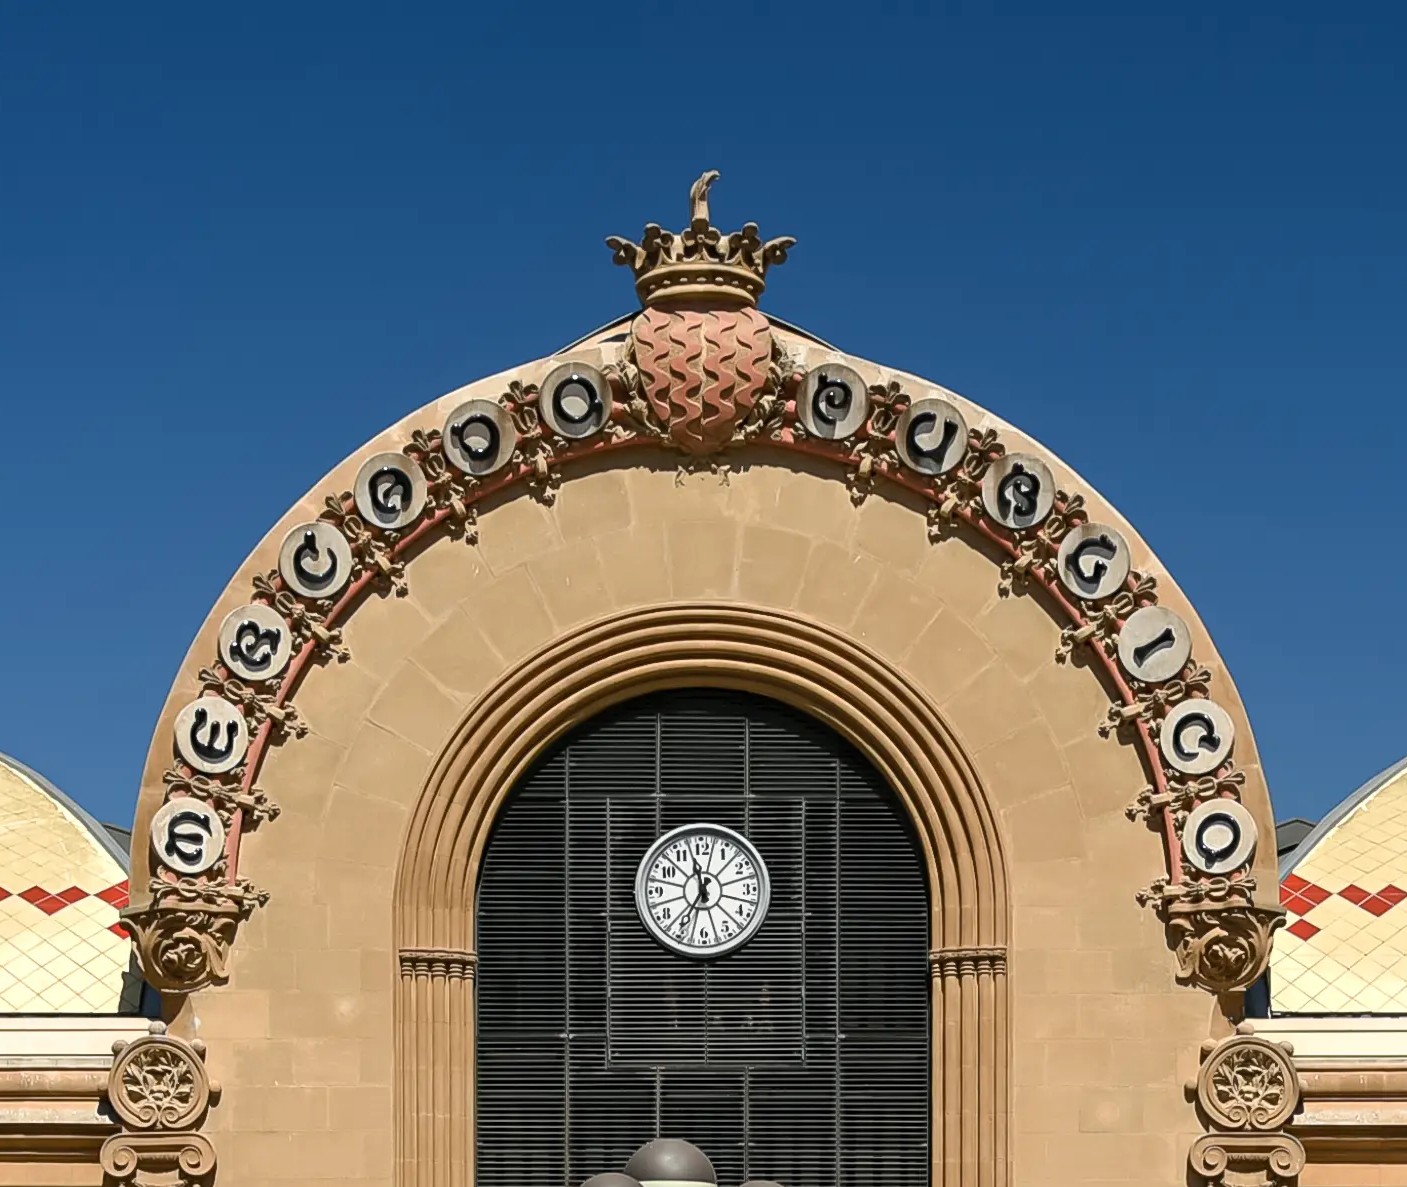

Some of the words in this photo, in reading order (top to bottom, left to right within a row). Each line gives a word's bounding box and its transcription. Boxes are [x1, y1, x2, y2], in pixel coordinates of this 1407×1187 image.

[164, 373, 603, 866] MERCADO
[696, 843, 710, 855] 12
[720, 848, 726, 860] 1
[676, 850, 687, 861] 11
[662, 866, 676, 878] 10
[735, 862, 743, 875] 2
[655, 886, 663, 898] 9
[743, 883, 750, 895] 3
[662, 908, 671, 920] 8
[735, 904, 743, 916] 4
[700, 927, 708, 939] 6
[721, 921, 729, 933] 5
